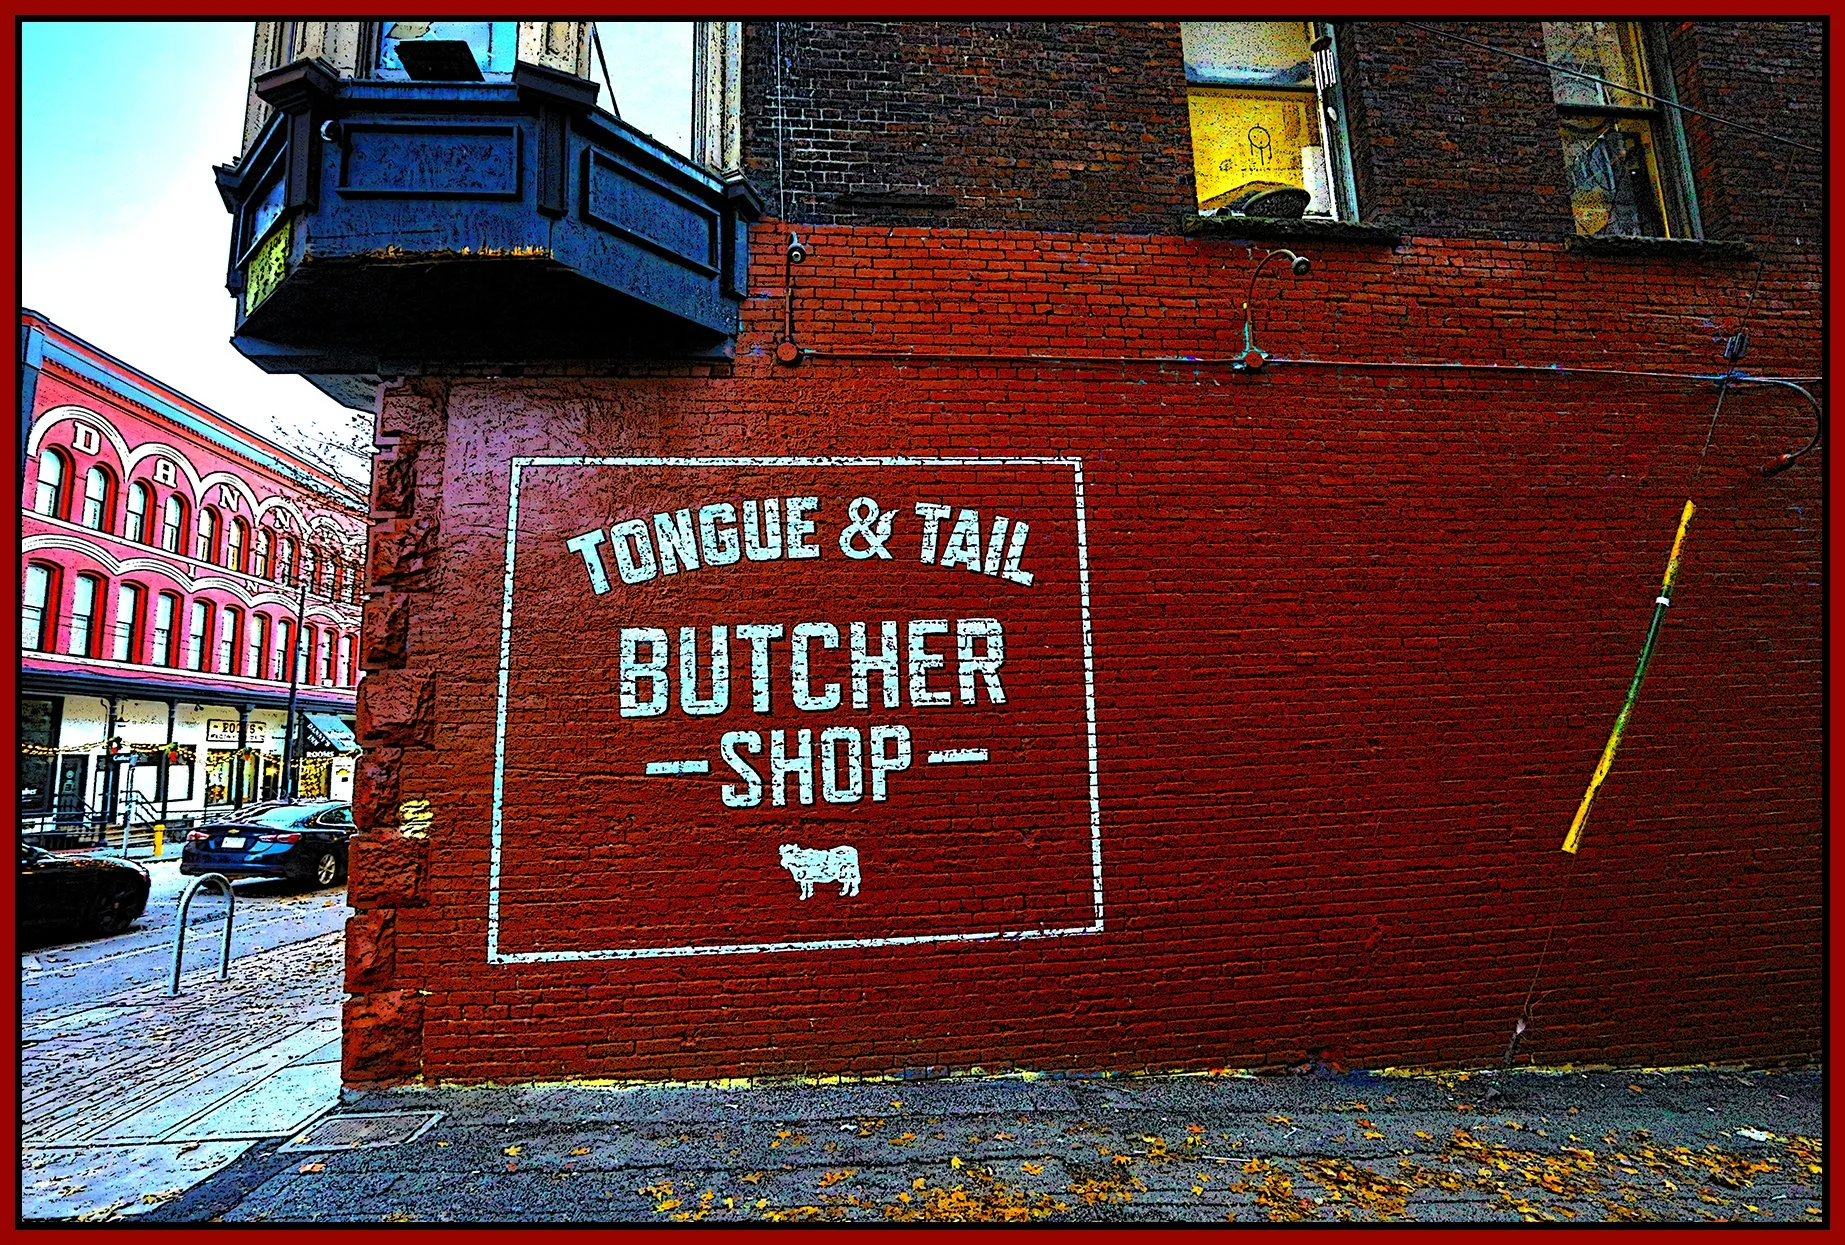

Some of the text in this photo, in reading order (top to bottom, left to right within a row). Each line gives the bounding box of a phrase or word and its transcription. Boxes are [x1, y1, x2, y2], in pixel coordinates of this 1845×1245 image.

[566, 496, 1034, 595] TONGUE & TAIL
[619, 617, 1008, 719] BUTCHER
[306, 750, 335, 758] ROOMS
[720, 724, 913, 808] SHOP
